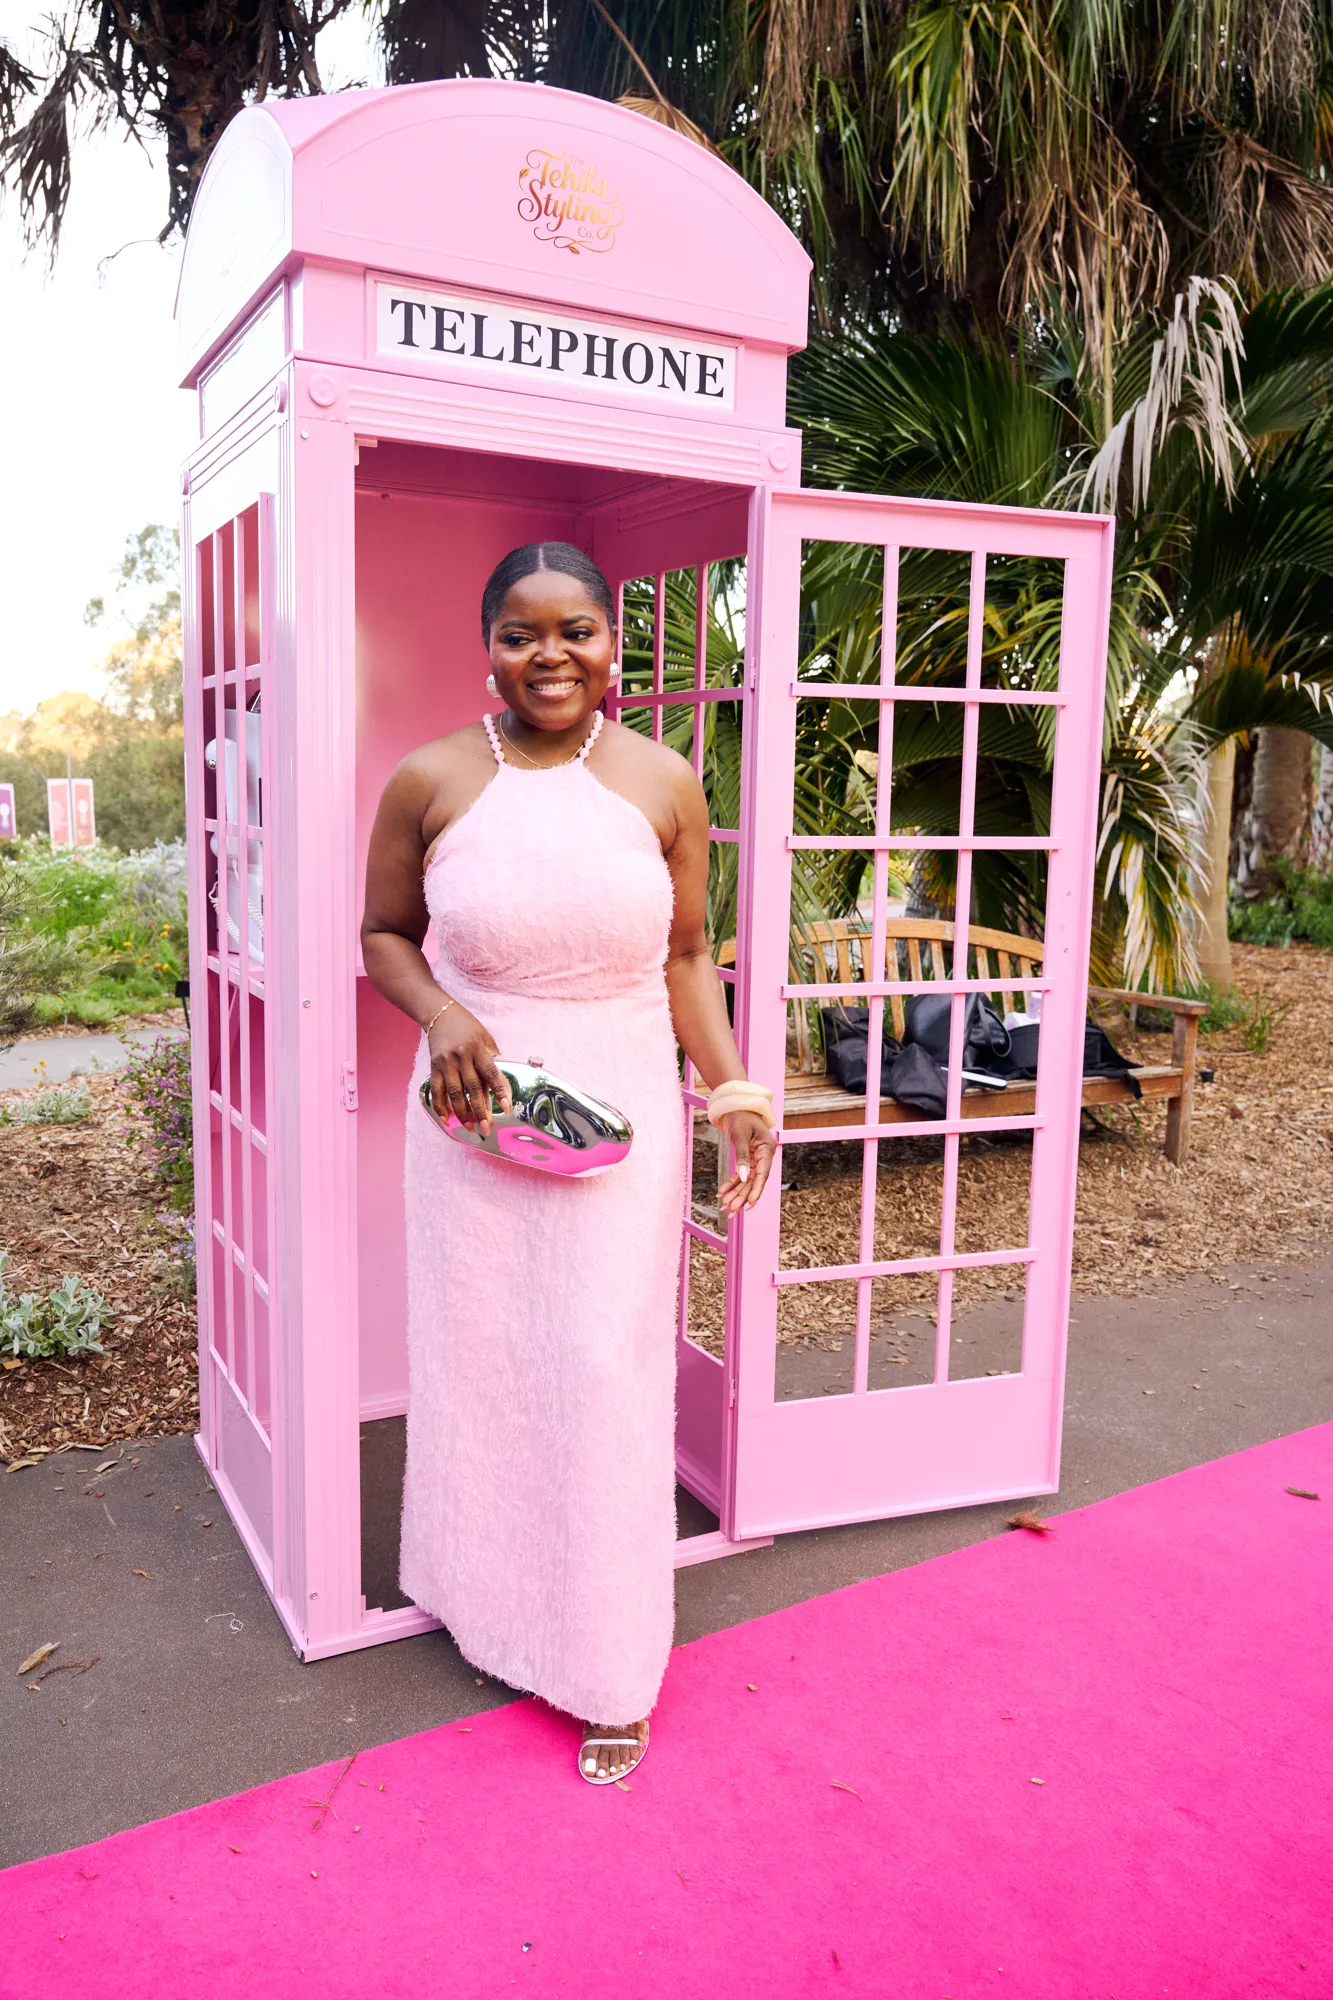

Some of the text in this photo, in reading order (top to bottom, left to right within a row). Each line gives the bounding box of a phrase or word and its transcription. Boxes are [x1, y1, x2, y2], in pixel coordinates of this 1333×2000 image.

[526, 149, 616, 202] Tehila
[518, 179, 625, 239] Styling
[391, 299, 724, 398] TELEPHONE
